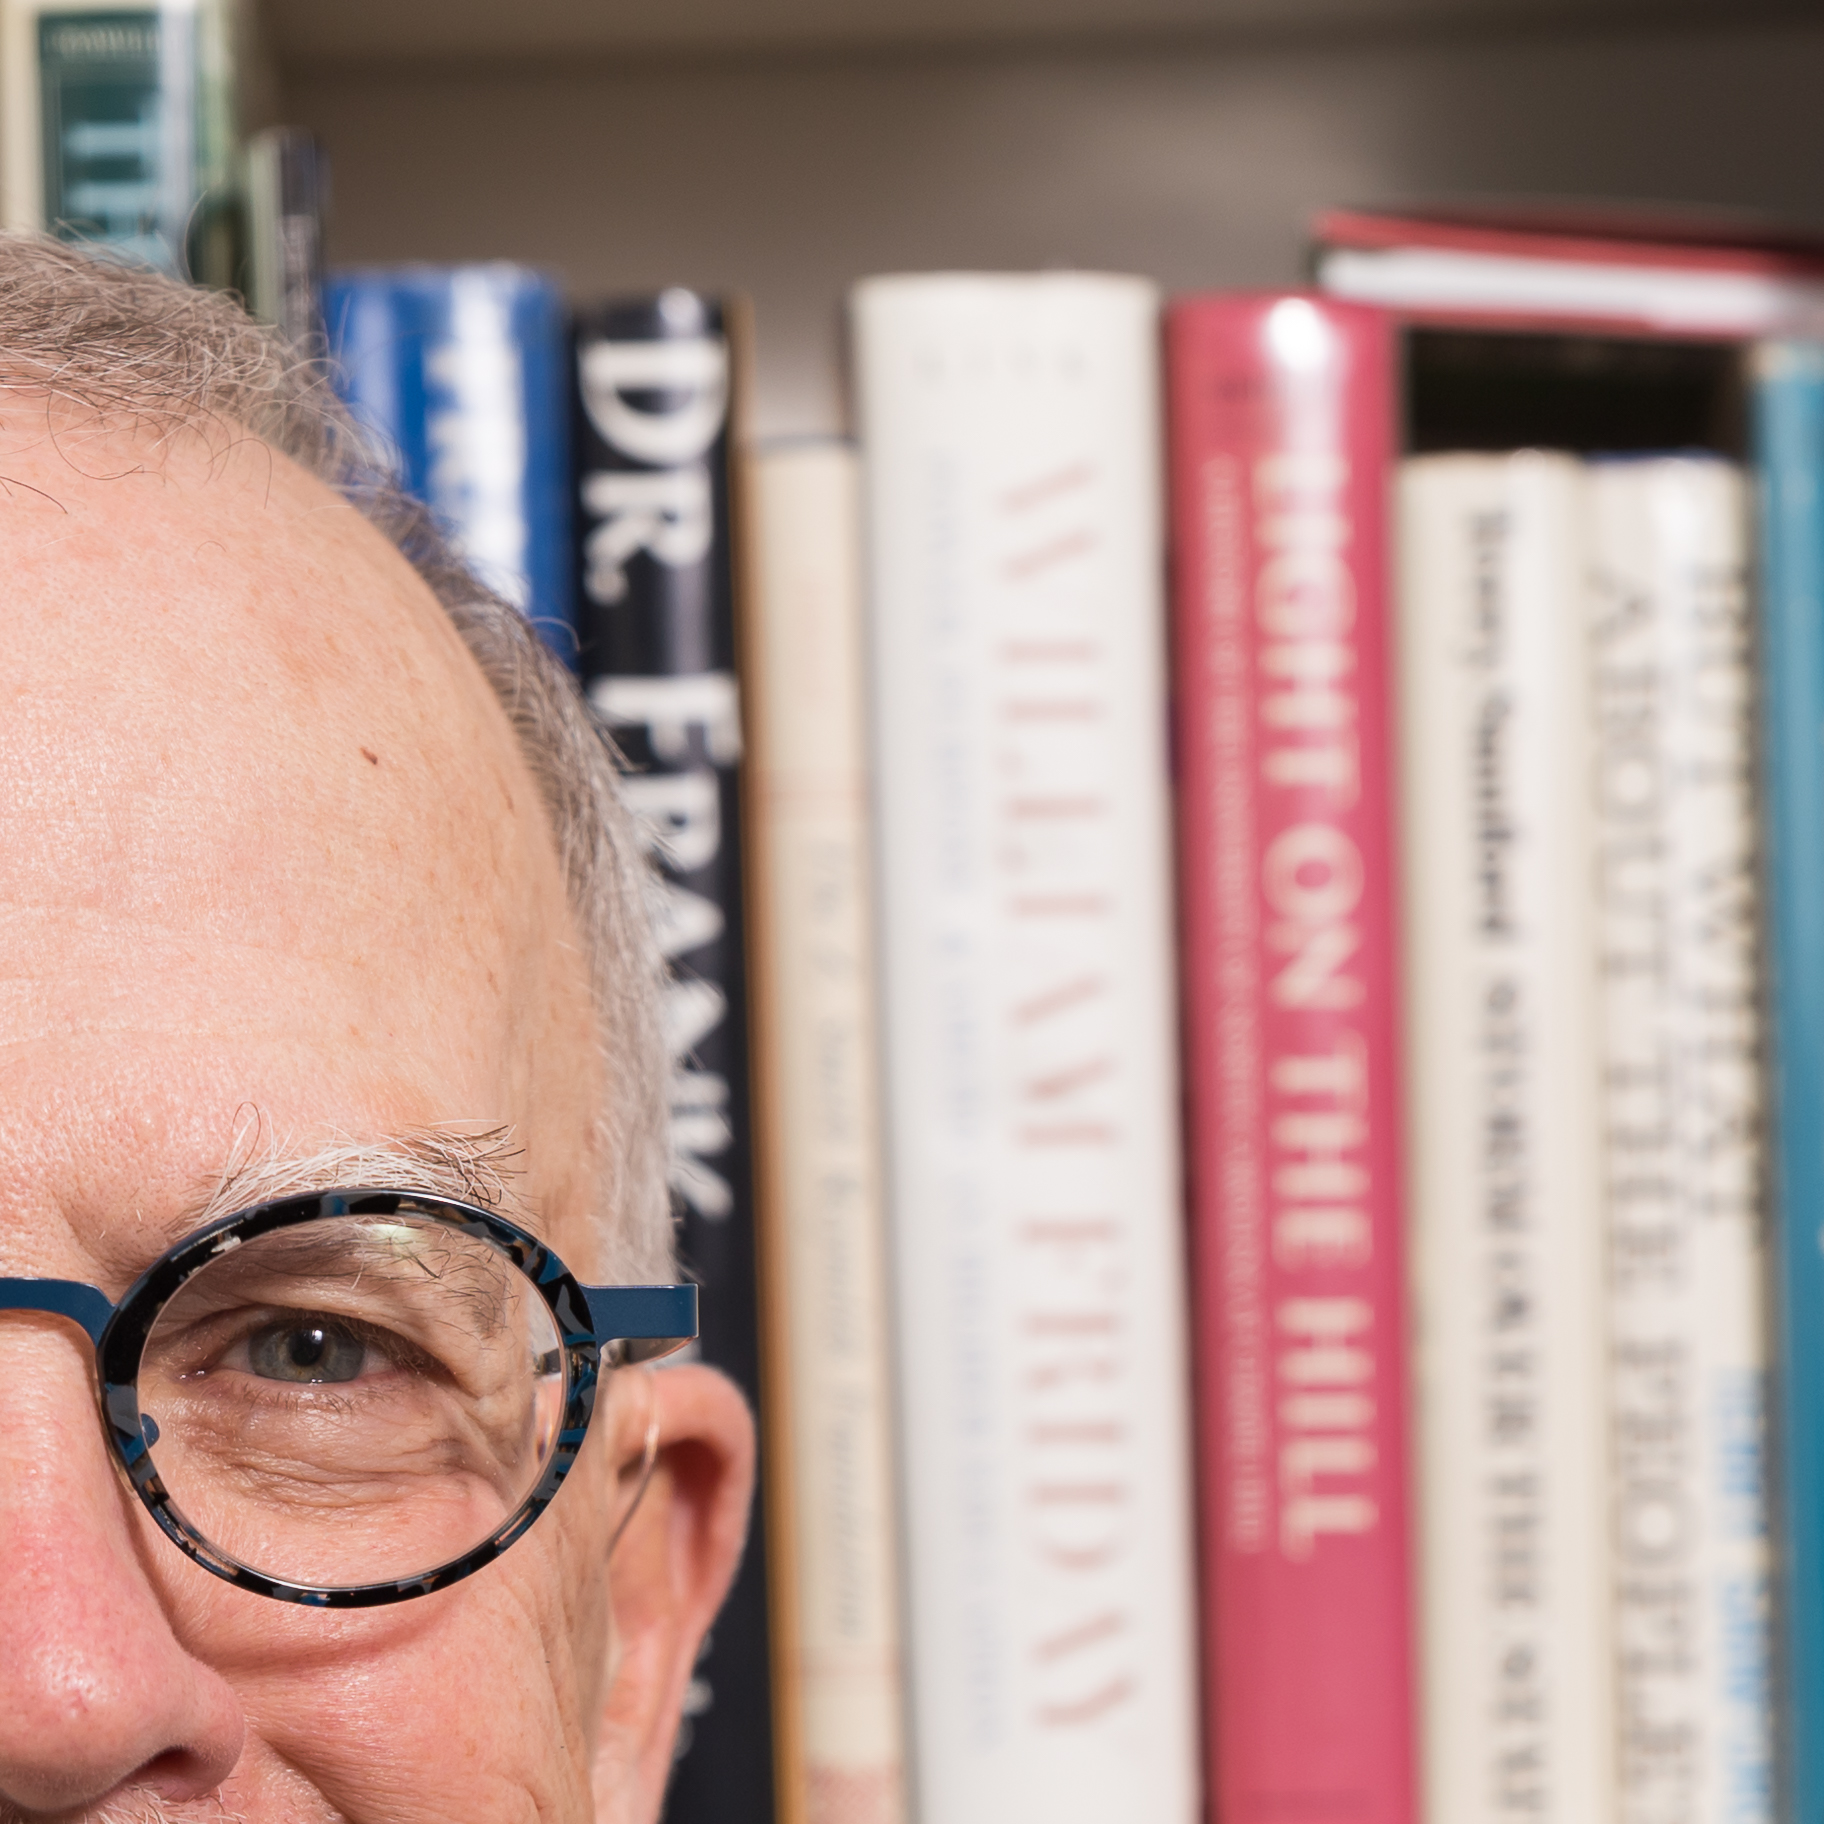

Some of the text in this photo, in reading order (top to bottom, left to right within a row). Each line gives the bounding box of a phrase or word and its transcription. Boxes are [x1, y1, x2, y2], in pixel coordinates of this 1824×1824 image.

[576, 333, 733, 610] DR.
[989, 450, 1126, 1152] WILLIAM
[1584, 566, 1676, 1002] ABOUT
[1256, 450, 1381, 1557] LIGHT ON THE HILL
[1596, 1039, 1688, 1295] THE
[1687, 843, 1771, 1245] WHAT
[1016, 1210, 1146, 1735] FRIDAY
[1486, 1463, 1548, 1612] THE
